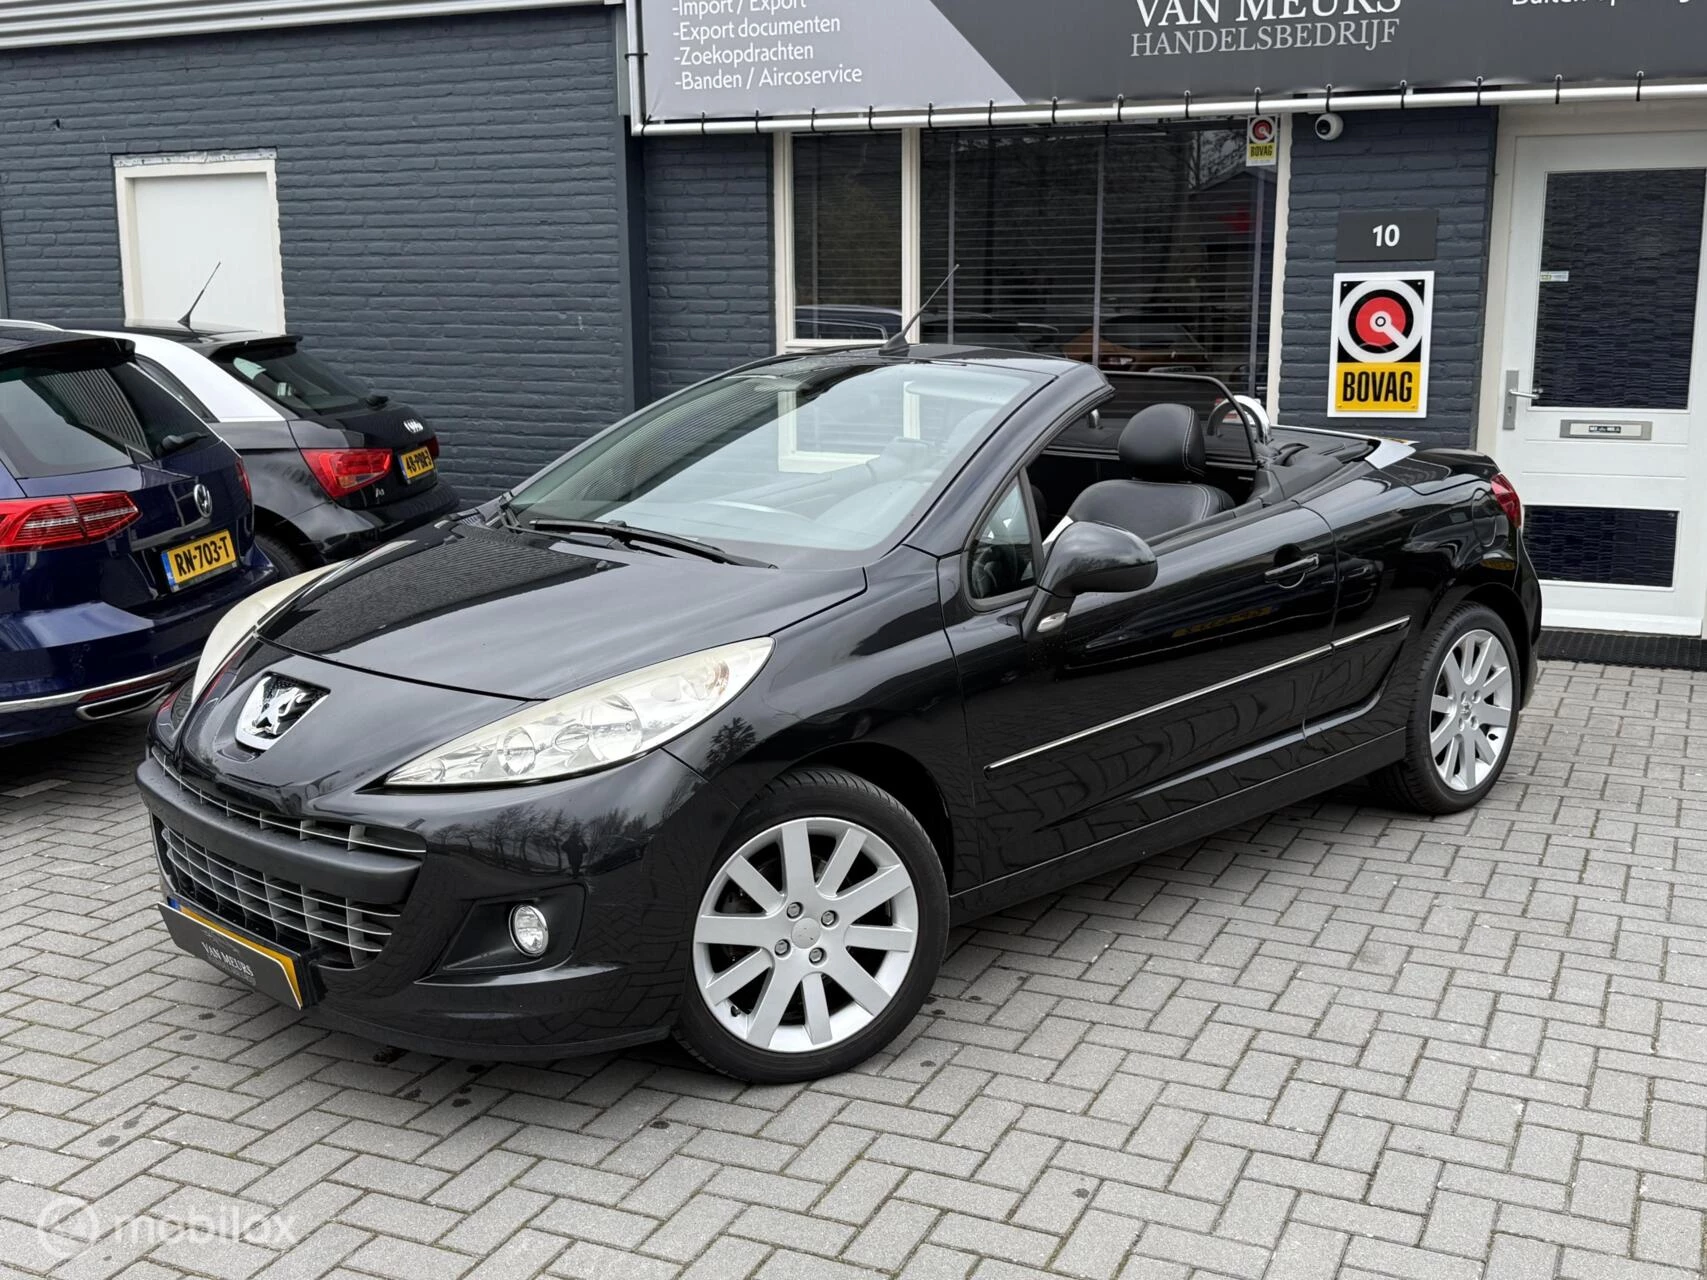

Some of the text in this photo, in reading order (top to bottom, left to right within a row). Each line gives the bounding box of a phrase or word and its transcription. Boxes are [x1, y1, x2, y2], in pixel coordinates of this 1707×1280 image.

[1136, 0, 1218, 27] VAN
[673, 16, 841, 45] -Export documenten
[1131, 18, 1400, 57] HANDELSBEDRIJF
[674, 40, 814, 68] -Zoekopdrachten
[675, 63, 862, 90] -Banden / Aircoservice
[1250, 145, 1273, 158] BOVAG
[1372, 224, 1400, 247] 10
[1342, 371, 1413, 402] BOVAG
[174, 536, 230, 577] RN-703-T
[201, 941, 222, 960] VAN
[220, 951, 255, 977] MEURS
